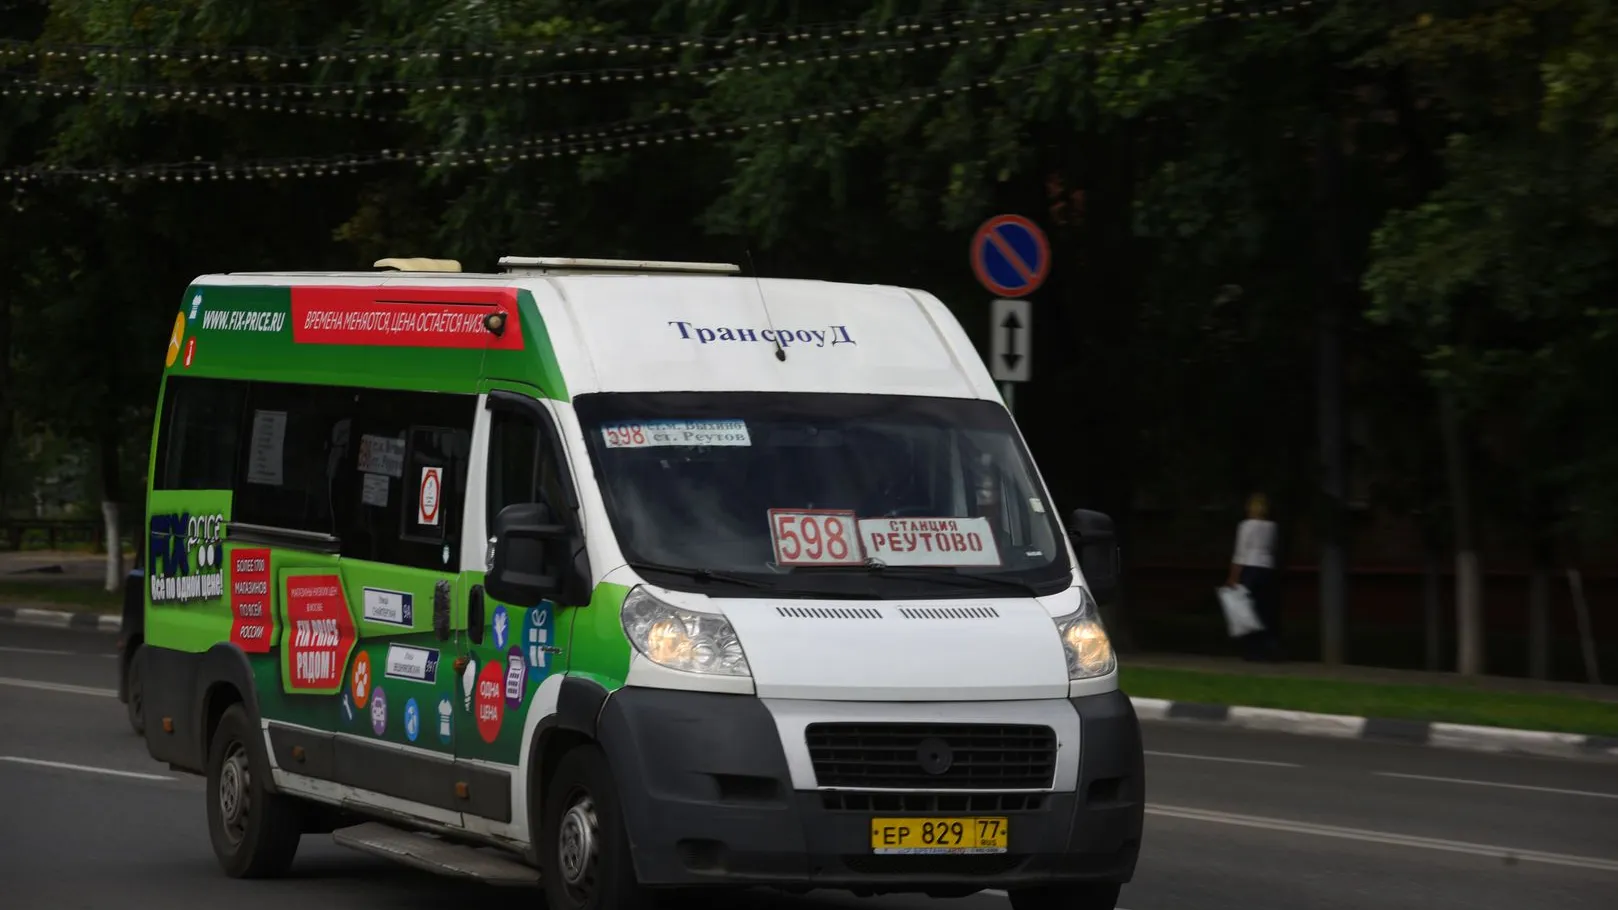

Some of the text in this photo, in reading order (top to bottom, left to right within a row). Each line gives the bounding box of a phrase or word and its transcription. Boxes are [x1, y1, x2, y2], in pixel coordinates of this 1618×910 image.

[304, 310, 343, 330] ВРЕМЕНА
[391, 312, 415, 333] ЦЕНА
[416, 310, 462, 333] ОСТАЁТСЯ
[606, 424, 646, 445] 598
[653, 431, 746, 444] ст. Реутов
[889, 520, 957, 533] СТАНЦИЯ
[778, 516, 849, 560] 598
[871, 532, 983, 553] РЕУТОВО
[236, 559, 254, 572] БОЛЕЕ
[151, 572, 165, 600] Всё
[166, 577, 176, 599] по
[176, 569, 201, 602] одной
[234, 581, 267, 595] МАГАЗИНОВ
[239, 625, 264, 639] РОССИИ
[295, 619, 339, 647] FIX PRICE
[480, 680, 499, 699] ОДНА
[480, 704, 498, 722] ЦЕНА
[921, 821, 964, 845] 829
[977, 820, 1001, 839] 77
